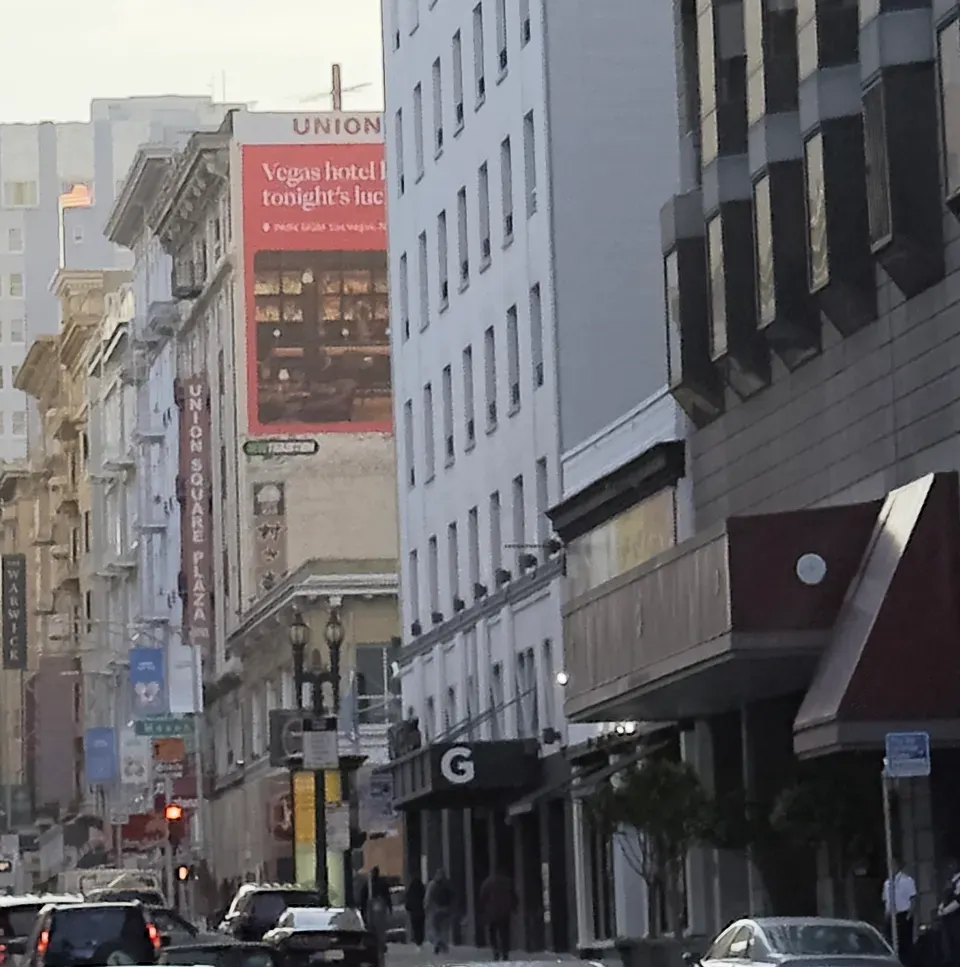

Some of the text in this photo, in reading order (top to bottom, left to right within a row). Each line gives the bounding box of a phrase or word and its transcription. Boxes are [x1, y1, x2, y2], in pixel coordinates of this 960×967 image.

[293, 117, 381, 135] UNION
[262, 161, 321, 187] Vegas
[325, 160, 376, 181] hotel
[262, 185, 351, 211] tonight's
[189, 385, 204, 451] UNION
[190, 459, 205, 543] SQUARE
[191, 551, 206, 620] PLAZA
[6, 569, 20, 661] WARWICK
[441, 746, 475, 784] G
